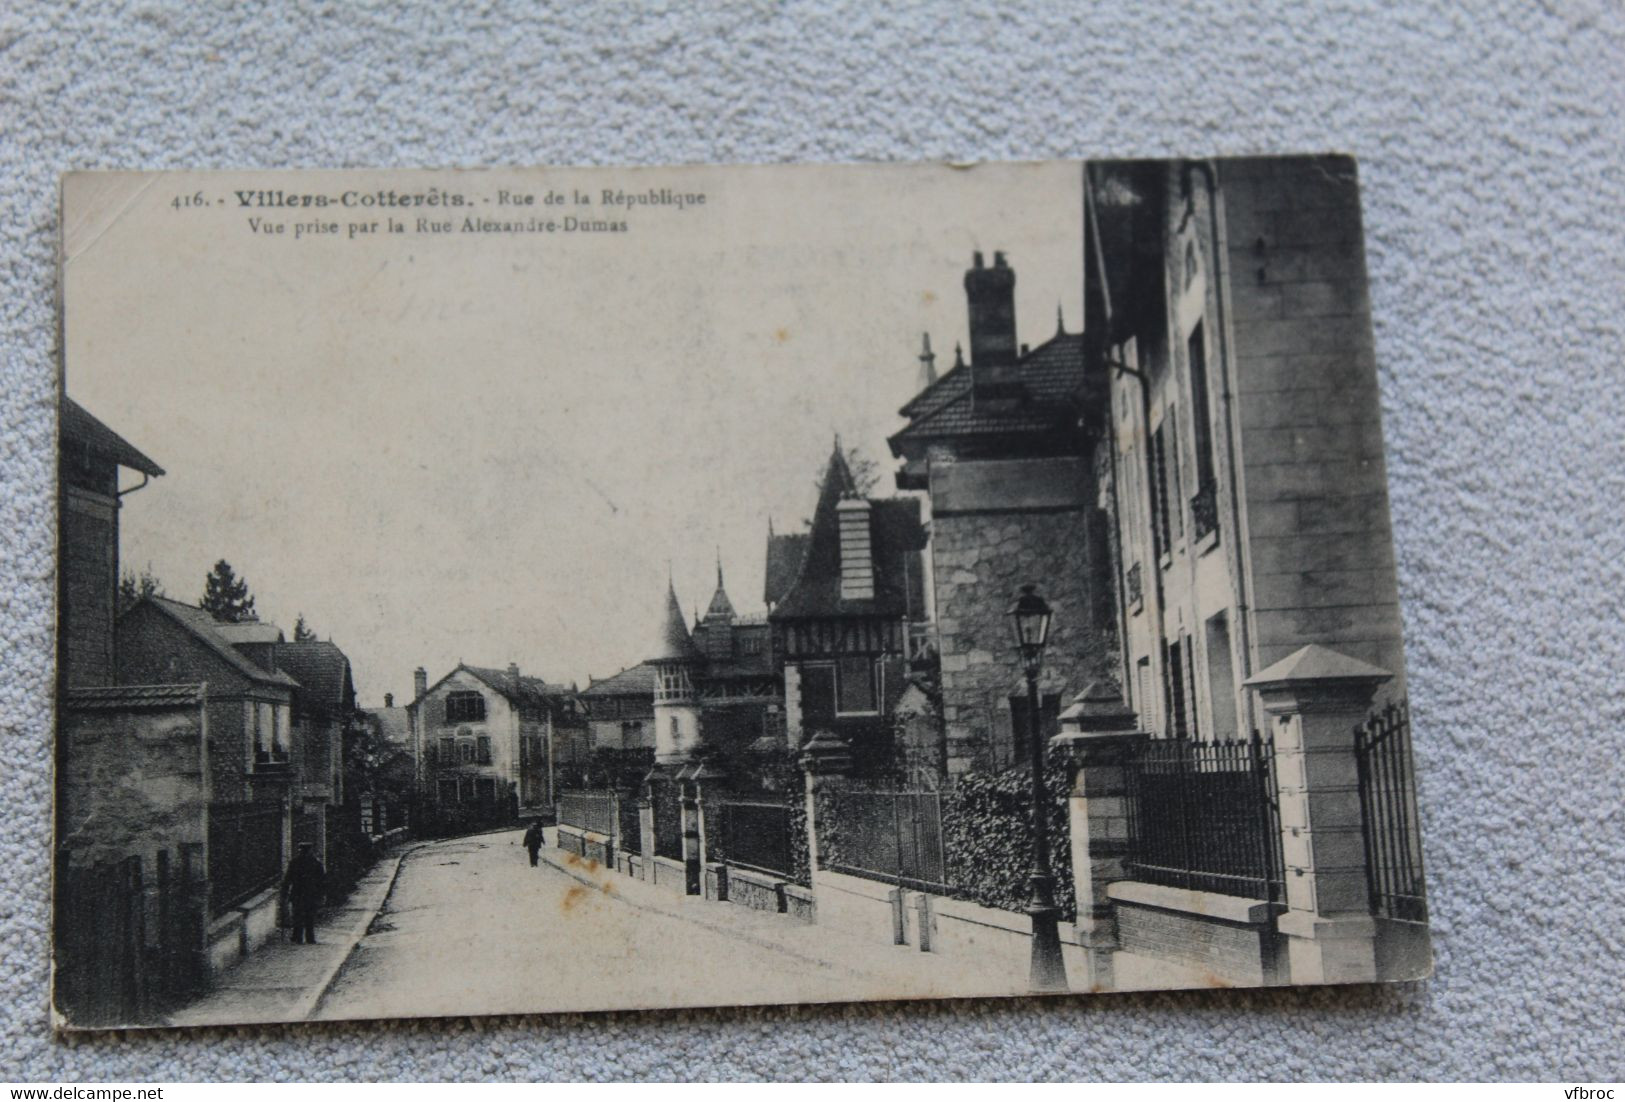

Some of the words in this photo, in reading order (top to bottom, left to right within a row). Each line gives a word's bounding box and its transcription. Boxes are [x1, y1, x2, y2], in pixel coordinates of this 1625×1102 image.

[170, 191, 210, 211] 416.
[234, 187, 475, 208] Villers-Cotterêts.
[498, 189, 535, 206] Rue
[543, 189, 565, 206] de
[573, 189, 590, 206] la
[602, 188, 706, 210] République
[248, 217, 285, 234] Vue
[294, 219, 339, 238] prise
[348, 221, 379, 239] par
[387, 217, 405, 234] la
[416, 217, 452, 233] Rue
[461, 216, 629, 234] Alexandre-Dumas
